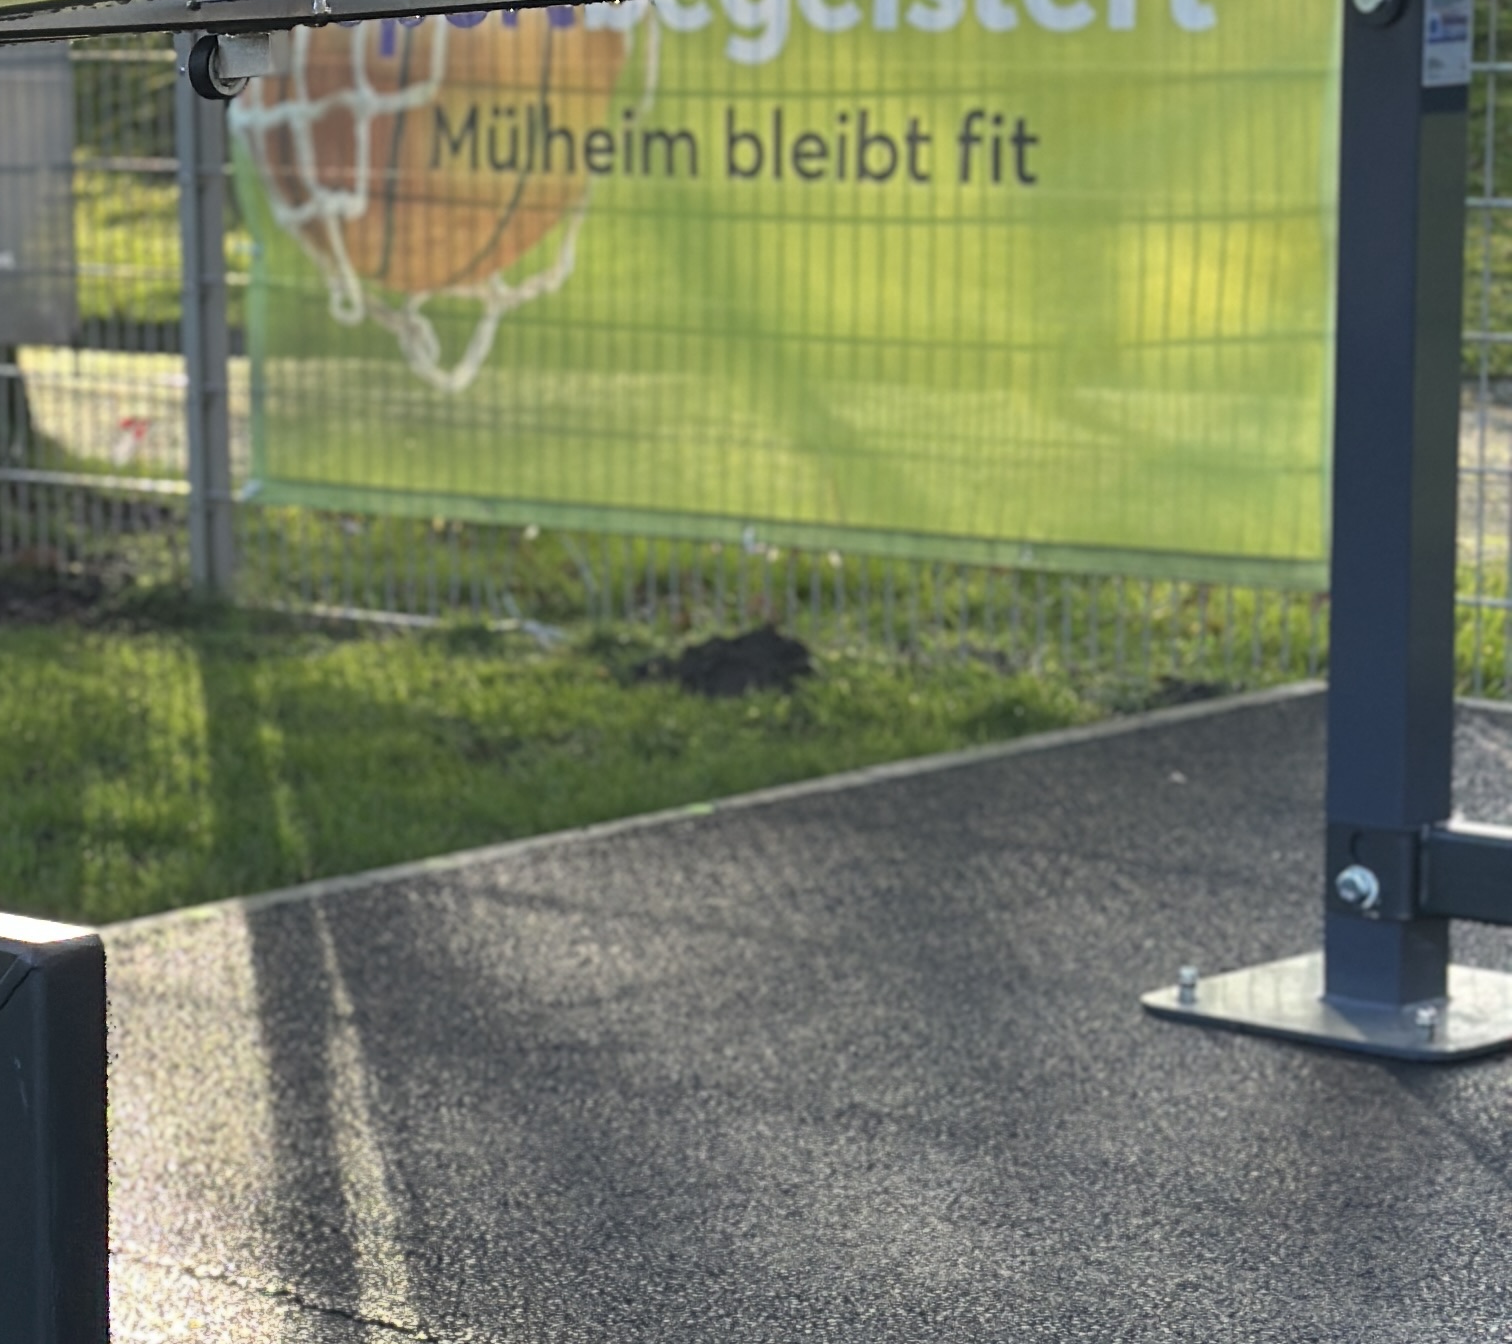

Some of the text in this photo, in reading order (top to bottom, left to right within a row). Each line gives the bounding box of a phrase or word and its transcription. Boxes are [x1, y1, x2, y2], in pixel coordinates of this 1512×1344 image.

[431, 103, 1040, 186] Mülheim bleibt fit
